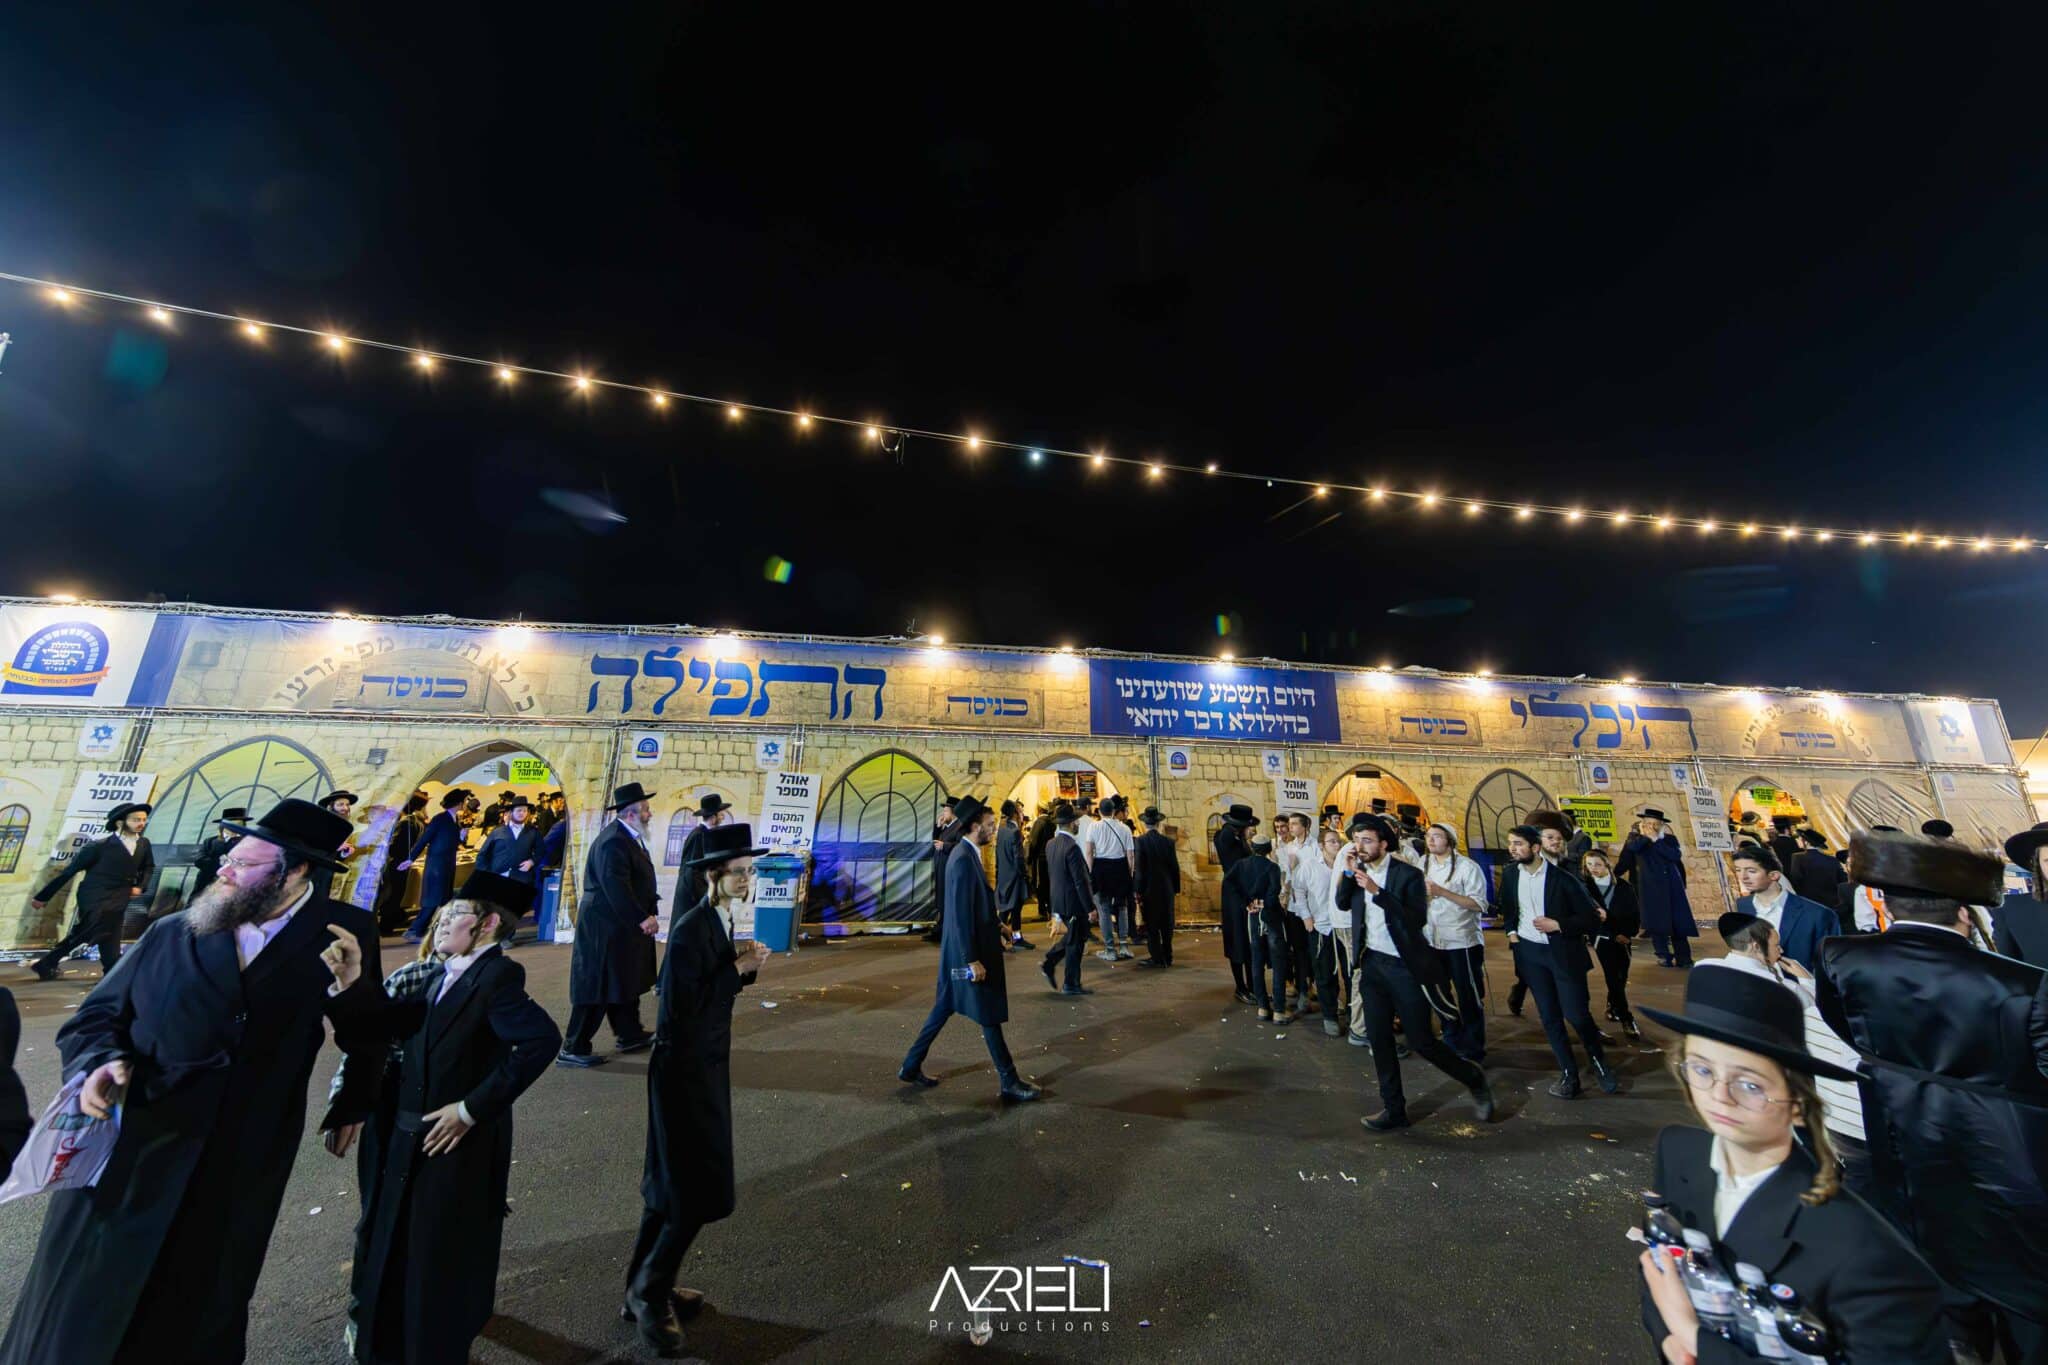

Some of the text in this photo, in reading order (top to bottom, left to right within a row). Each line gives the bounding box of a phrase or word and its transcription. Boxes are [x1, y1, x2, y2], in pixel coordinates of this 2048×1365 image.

[359, 674, 469, 699] כניסה
[586, 646, 887, 722] התפילה
[1115, 677, 1316, 708] היום תשמע שוועתינו
[946, 695, 1029, 718] כניסה
[1126, 704, 1311, 735] בהילולא דבר יוחאי
[1400, 716, 1468, 736] כניסה
[1510, 691, 1699, 751] היכלי
[97, 773, 138, 787] אוהל
[779, 773, 809, 786] אוהל
[1283, 779, 1307, 790] אוהל
[88, 788, 134, 801] מספר
[776, 786, 809, 798] מספר
[1283, 790, 1309, 800] מספר
[1693, 786, 1713, 796] אוהל
[1693, 797, 1717, 807] מספר
[772, 812, 804, 824] המקום
[765, 887, 787, 897] גניזה
